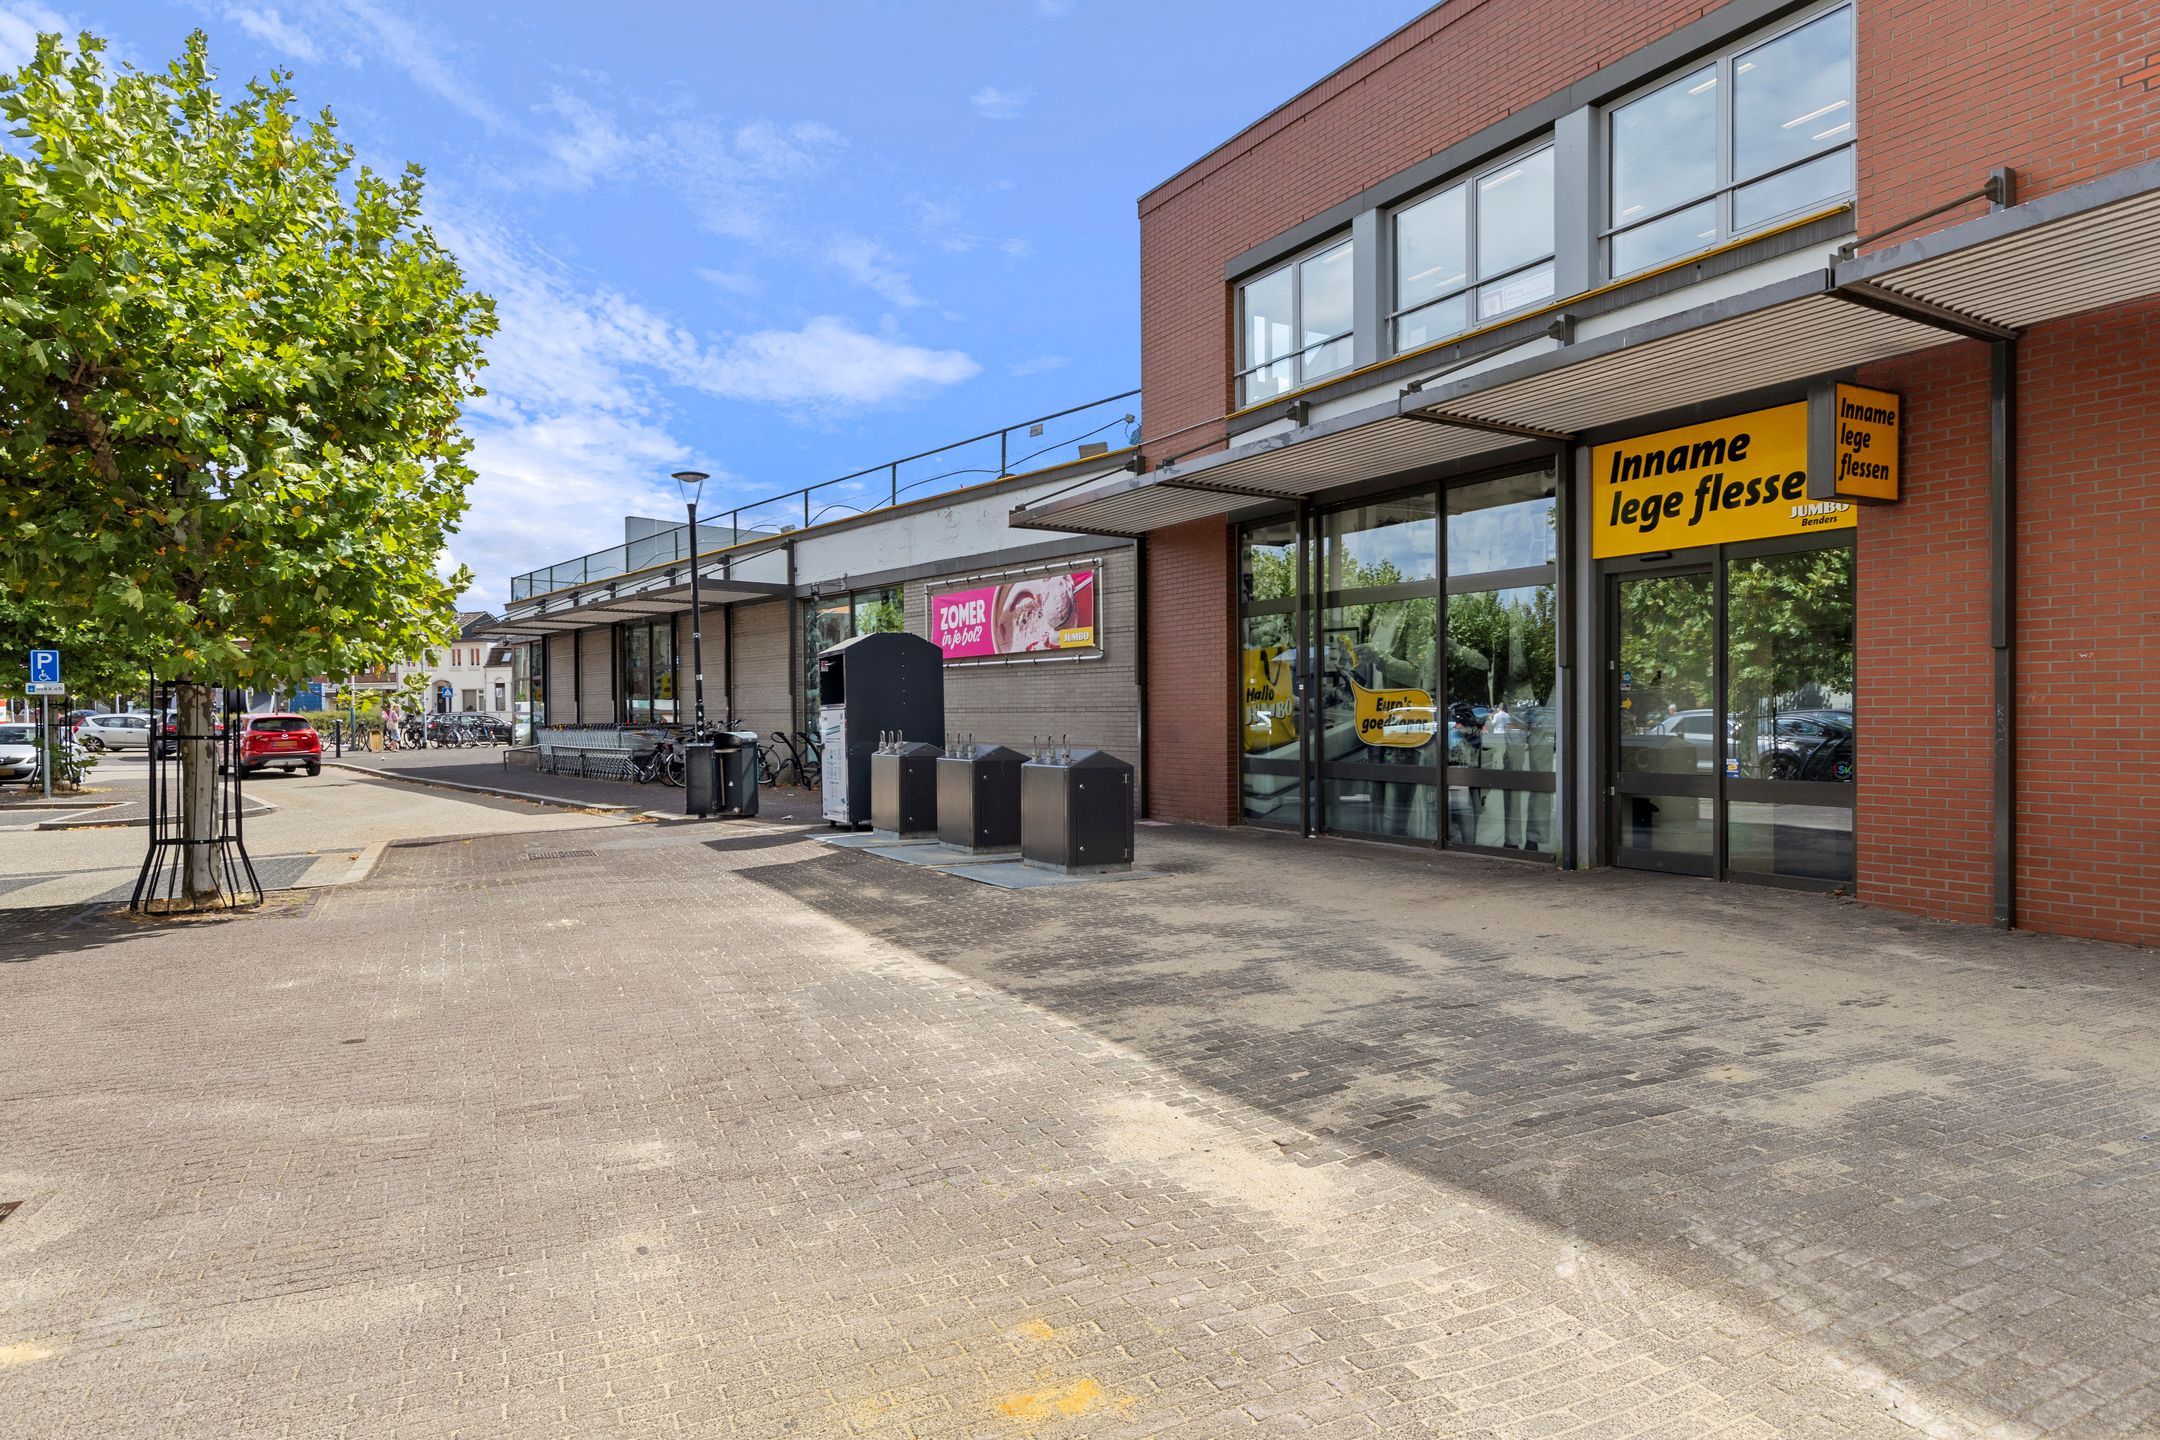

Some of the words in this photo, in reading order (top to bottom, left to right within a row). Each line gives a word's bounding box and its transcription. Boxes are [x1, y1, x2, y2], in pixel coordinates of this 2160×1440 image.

[1840, 397, 1896, 426] Inname
[1840, 422, 1871, 453] lege
[1609, 433, 1751, 484] Inname
[1838, 452, 1889, 481] flessen
[1609, 491, 1684, 533] lege
[1688, 471, 1807, 526] flesse
[1789, 501, 1850, 519] JUMBO
[1801, 515, 1838, 527] Benders
[940, 600, 986, 630] ZOMER
[942, 631, 953, 647] in
[950, 629, 961, 650] je
[962, 625, 983, 646] bol?
[1064, 632, 1089, 643] JUMBO
[37, 652, 53, 669] P
[1246, 684, 1275, 703] Hallo
